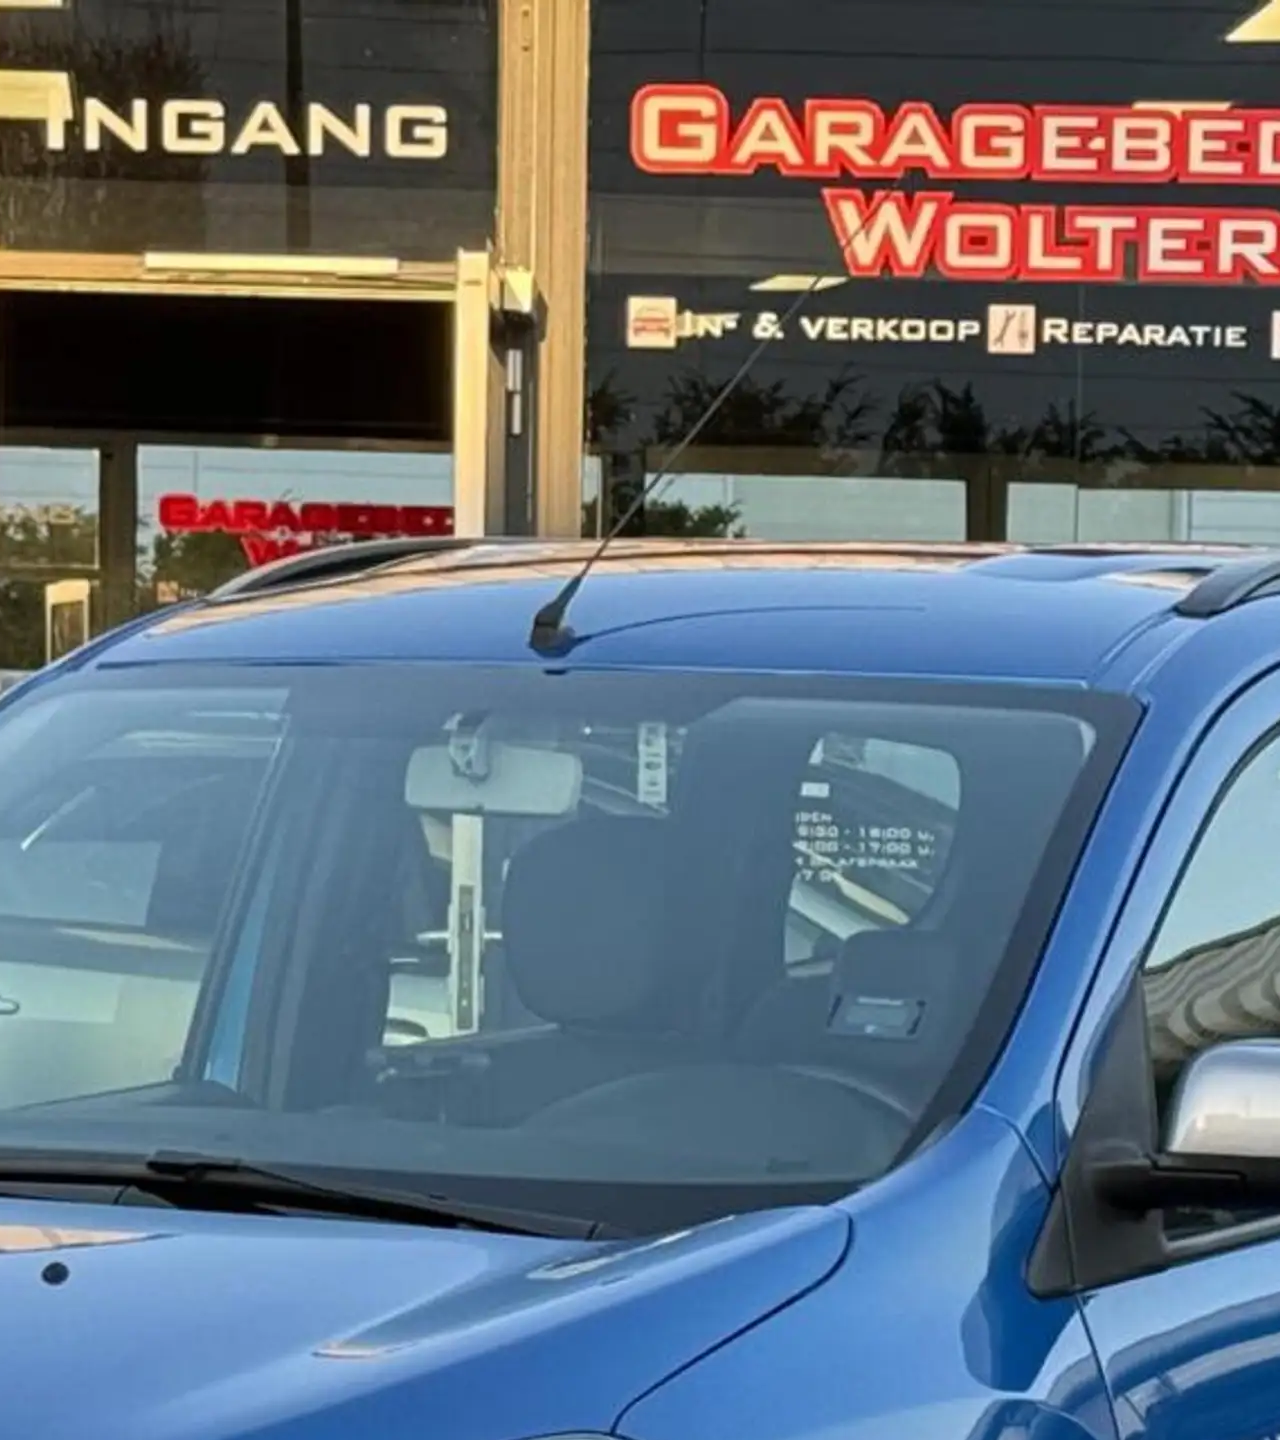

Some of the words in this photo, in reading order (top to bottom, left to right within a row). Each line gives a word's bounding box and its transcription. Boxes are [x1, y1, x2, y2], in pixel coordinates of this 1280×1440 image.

[44, 92, 449, 158] INGANG
[752, 312, 784, 339] &
[800, 315, 980, 342] VERKOOP
[1042, 317, 1247, 348] REPARATIE
